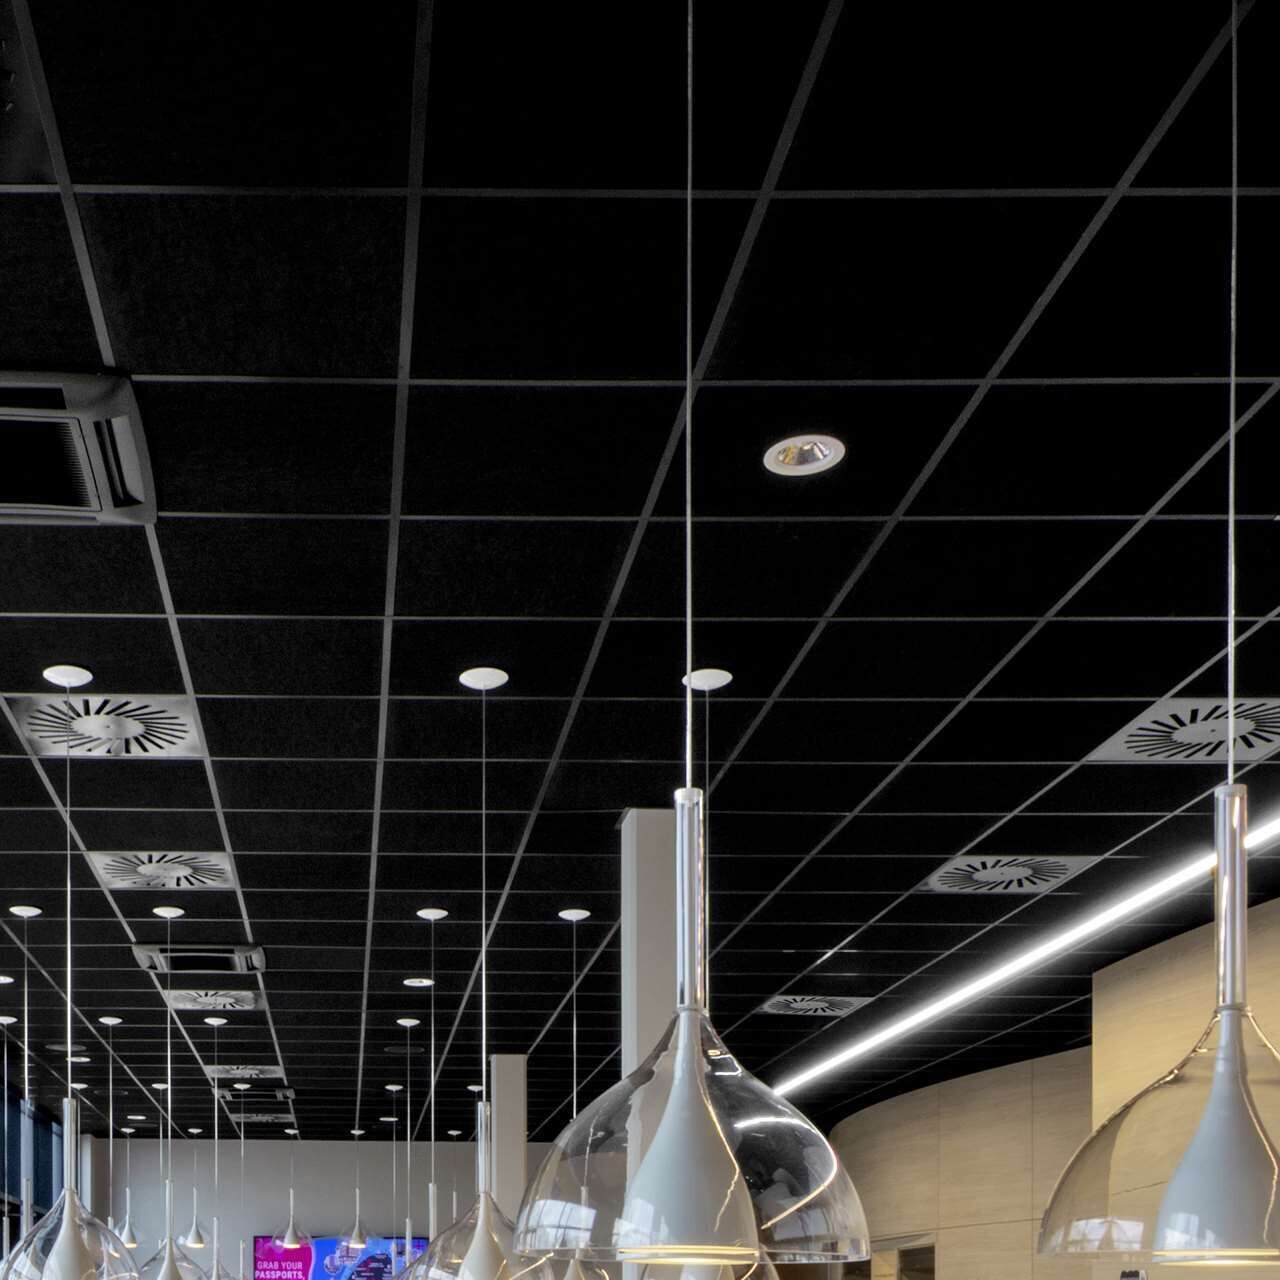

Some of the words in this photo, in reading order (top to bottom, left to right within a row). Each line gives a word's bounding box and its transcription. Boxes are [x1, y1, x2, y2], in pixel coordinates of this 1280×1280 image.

[257, 1261, 279, 1270] GRAB
[281, 1261, 303, 1270] YOUR
[255, 1270, 305, 1280] PASSPORTS,
